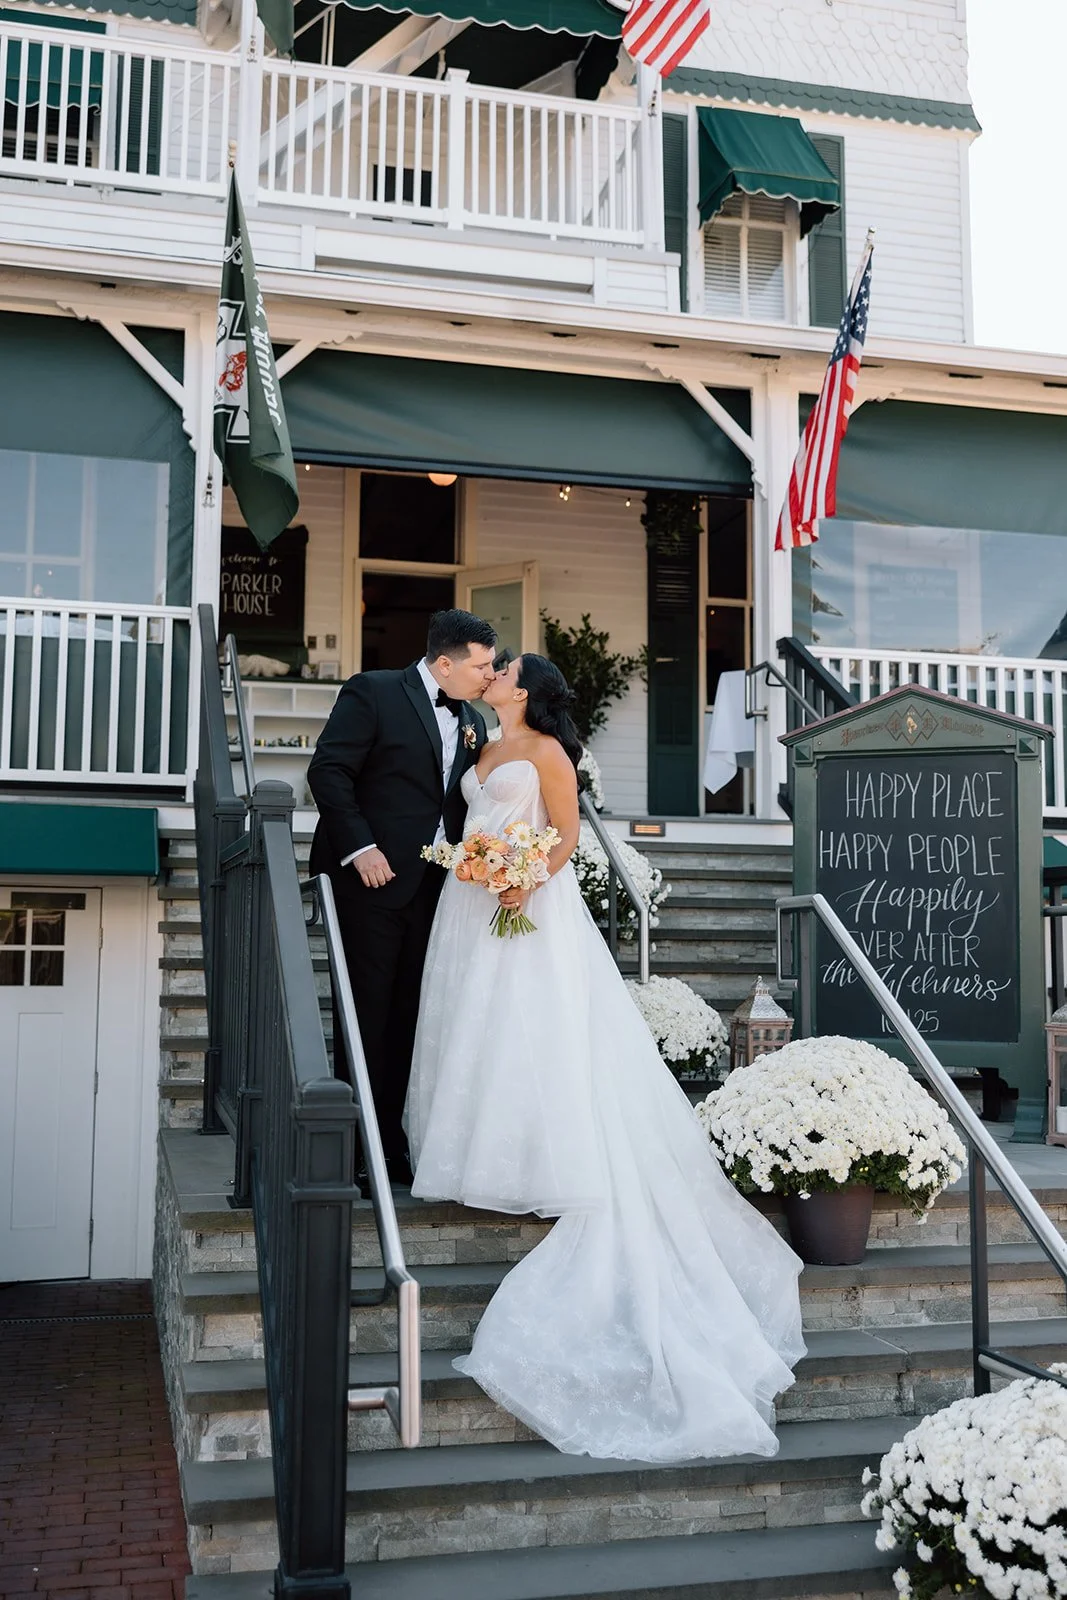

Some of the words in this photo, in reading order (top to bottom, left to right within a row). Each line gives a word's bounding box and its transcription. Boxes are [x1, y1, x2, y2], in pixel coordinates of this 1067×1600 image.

[221, 572, 282, 595] PARKER
[223, 593, 275, 616] HOUSE
[845, 769, 923, 819] HAPPY
[931, 770, 1004, 819] PLACE
[819, 830, 893, 872] HAPPY
[907, 832, 1005, 876] PEOPLE
[835, 876, 1000, 938] Happily
[913, 931, 981, 968] AFTER
[820, 958, 859, 987] the
